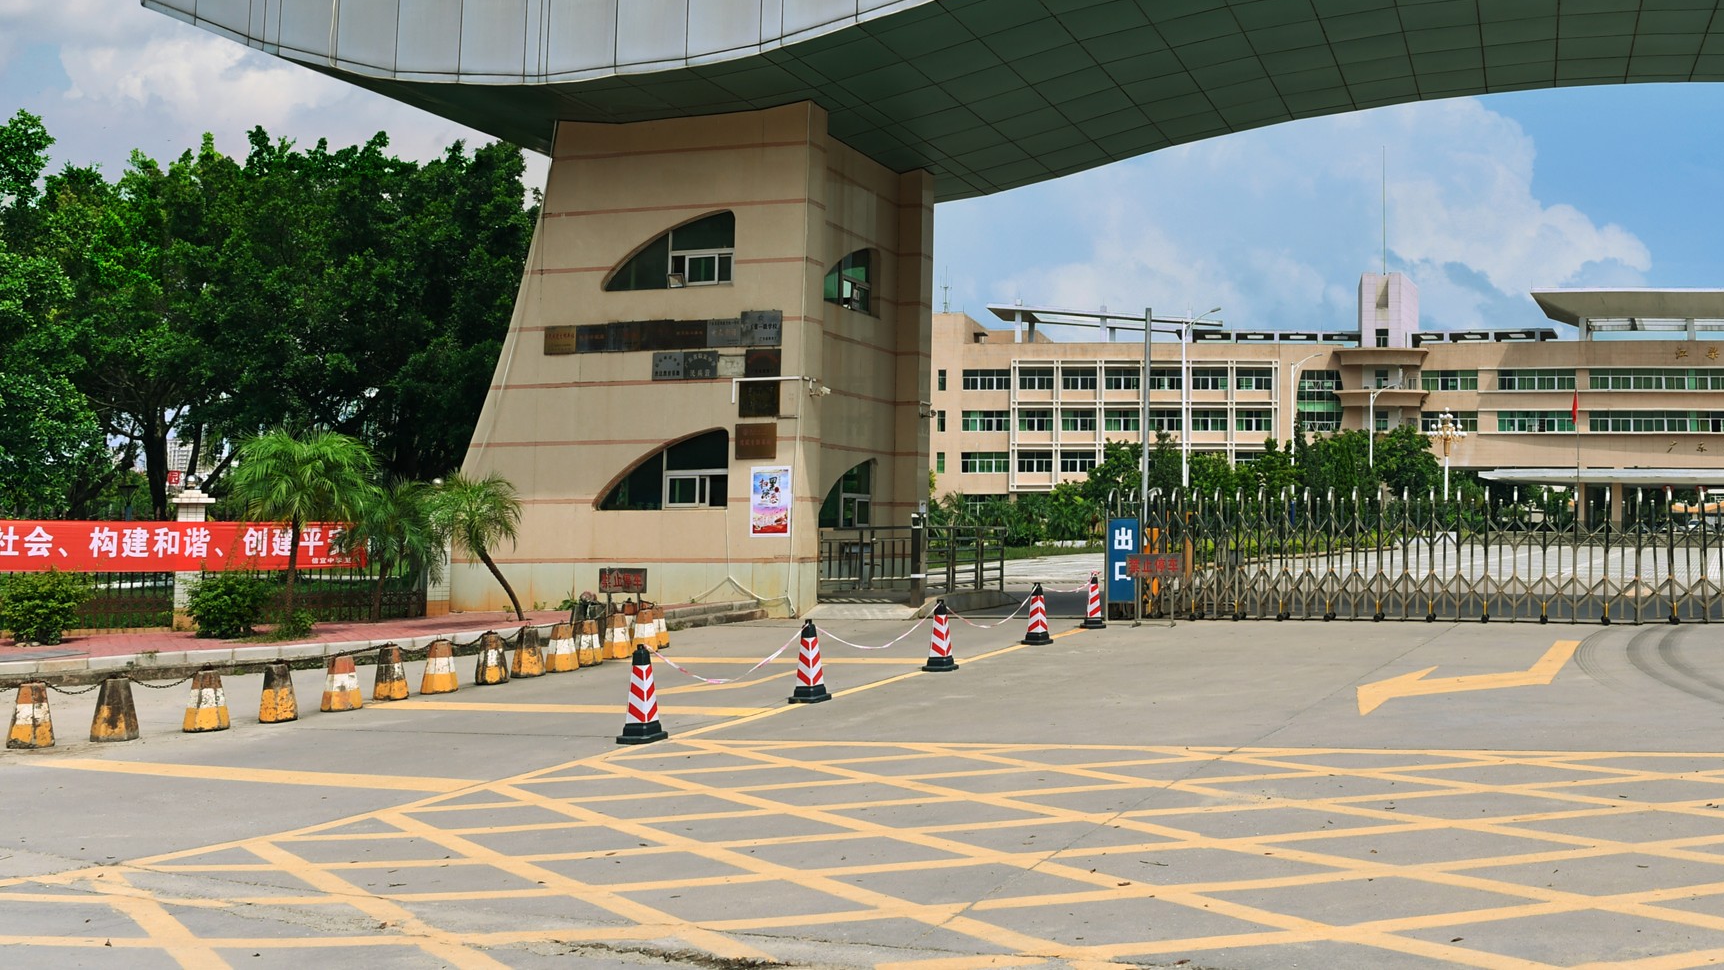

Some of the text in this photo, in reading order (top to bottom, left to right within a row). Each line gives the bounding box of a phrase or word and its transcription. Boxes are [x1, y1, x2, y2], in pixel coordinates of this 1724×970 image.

[1128, 558, 1179, 573] 禁止停车
[601, 572, 642, 589] 禁止停车
